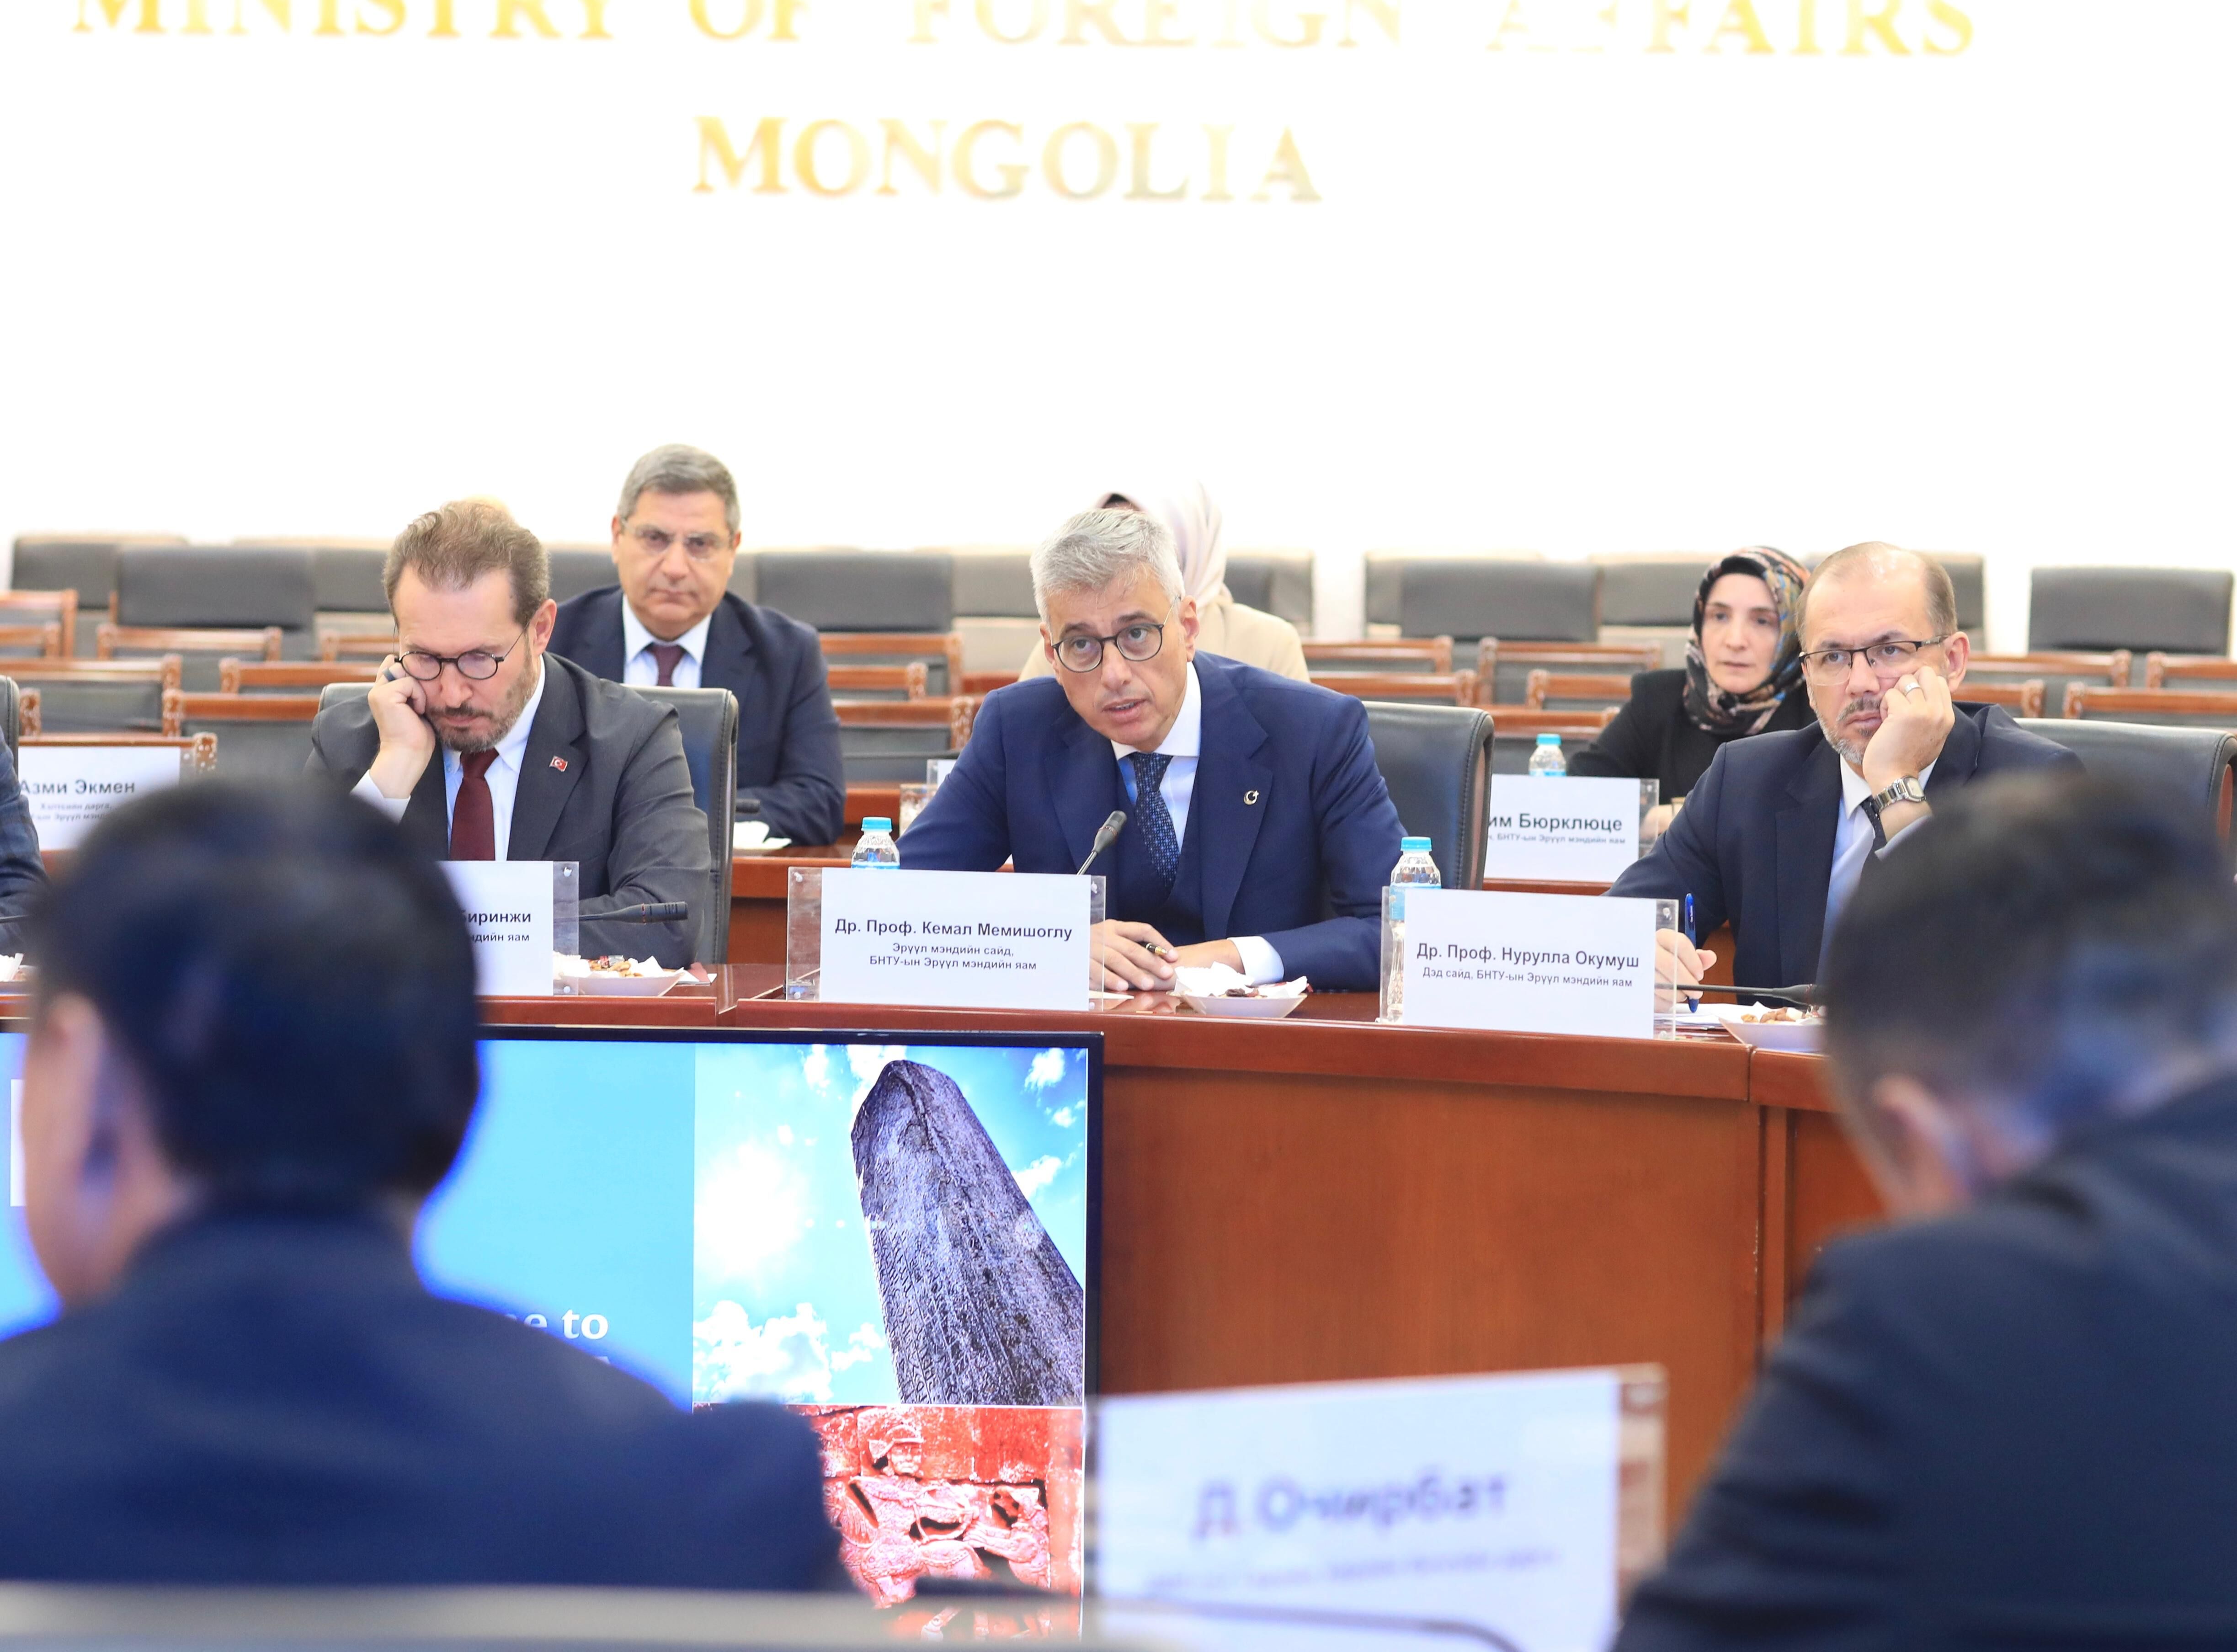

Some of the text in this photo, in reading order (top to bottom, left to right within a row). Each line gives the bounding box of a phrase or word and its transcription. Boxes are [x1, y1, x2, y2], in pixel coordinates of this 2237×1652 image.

[1485, 0, 1974, 57] AFAIRS
[691, 116, 1323, 203] MONGOLIA
[21, 779, 135, 794] Азми Экмен
[1519, 813, 1622, 832] Бюрклюце
[461, 909, 531, 926] иринжи
[835, 918, 1072, 941] Др. Проф. Кемал Мемишоглу
[893, 943, 1014, 957] Эрүүл мэндийн сайд,
[1417, 943, 1639, 970] Др. Проф. Нурулла Окумуш
[870, 955, 920, 965] БНТУ-ын
[924, 957, 958, 969] Эрүүл
[962, 959, 1011, 969] мэндийн
[1422, 967, 1442, 977] Дэд
[1446, 969, 1473, 980] сайд,
[1477, 970, 1523, 980] БНТУ-ын
[1528, 972, 1559, 984] Эрүүл
[1563, 975, 1608, 985] мэндийн
[561, 1309, 609, 1339] to
